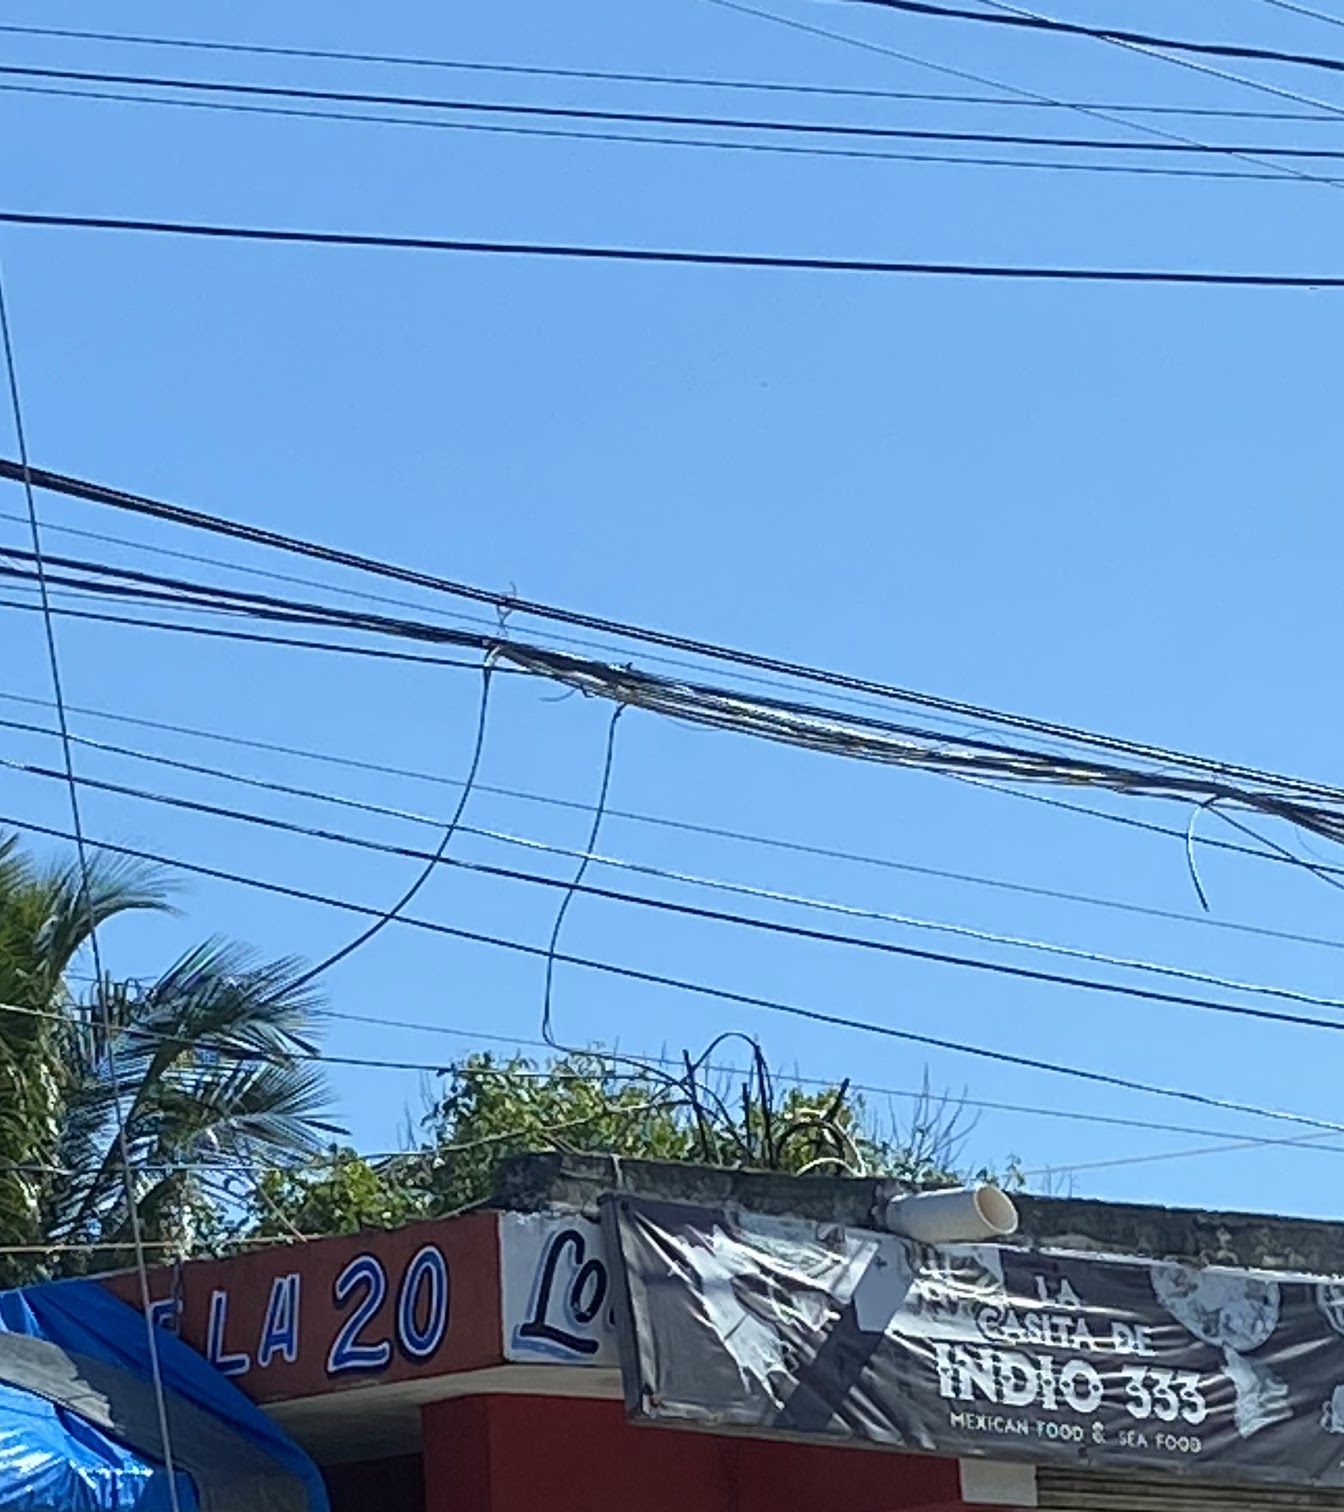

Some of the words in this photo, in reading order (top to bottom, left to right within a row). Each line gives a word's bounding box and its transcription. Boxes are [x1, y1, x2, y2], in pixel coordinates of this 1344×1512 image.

[208, 1273, 301, 1376] LA
[327, 1244, 449, 1373] 20
[514, 1229, 614, 1357] Lo
[1035, 1276, 1080, 1308] LA
[976, 1306, 1096, 1352] CASITA
[1111, 1321, 1156, 1356] DE
[936, 1343, 1104, 1413] INDIO
[1122, 1364, 1206, 1425] 333
[949, 1411, 1029, 1436] MEXICAN
[1036, 1420, 1083, 1442] FOOD
[1092, 1421, 1106, 1444] &
[1119, 1429, 1148, 1449] SEA
[1156, 1434, 1202, 1453] FOOD
